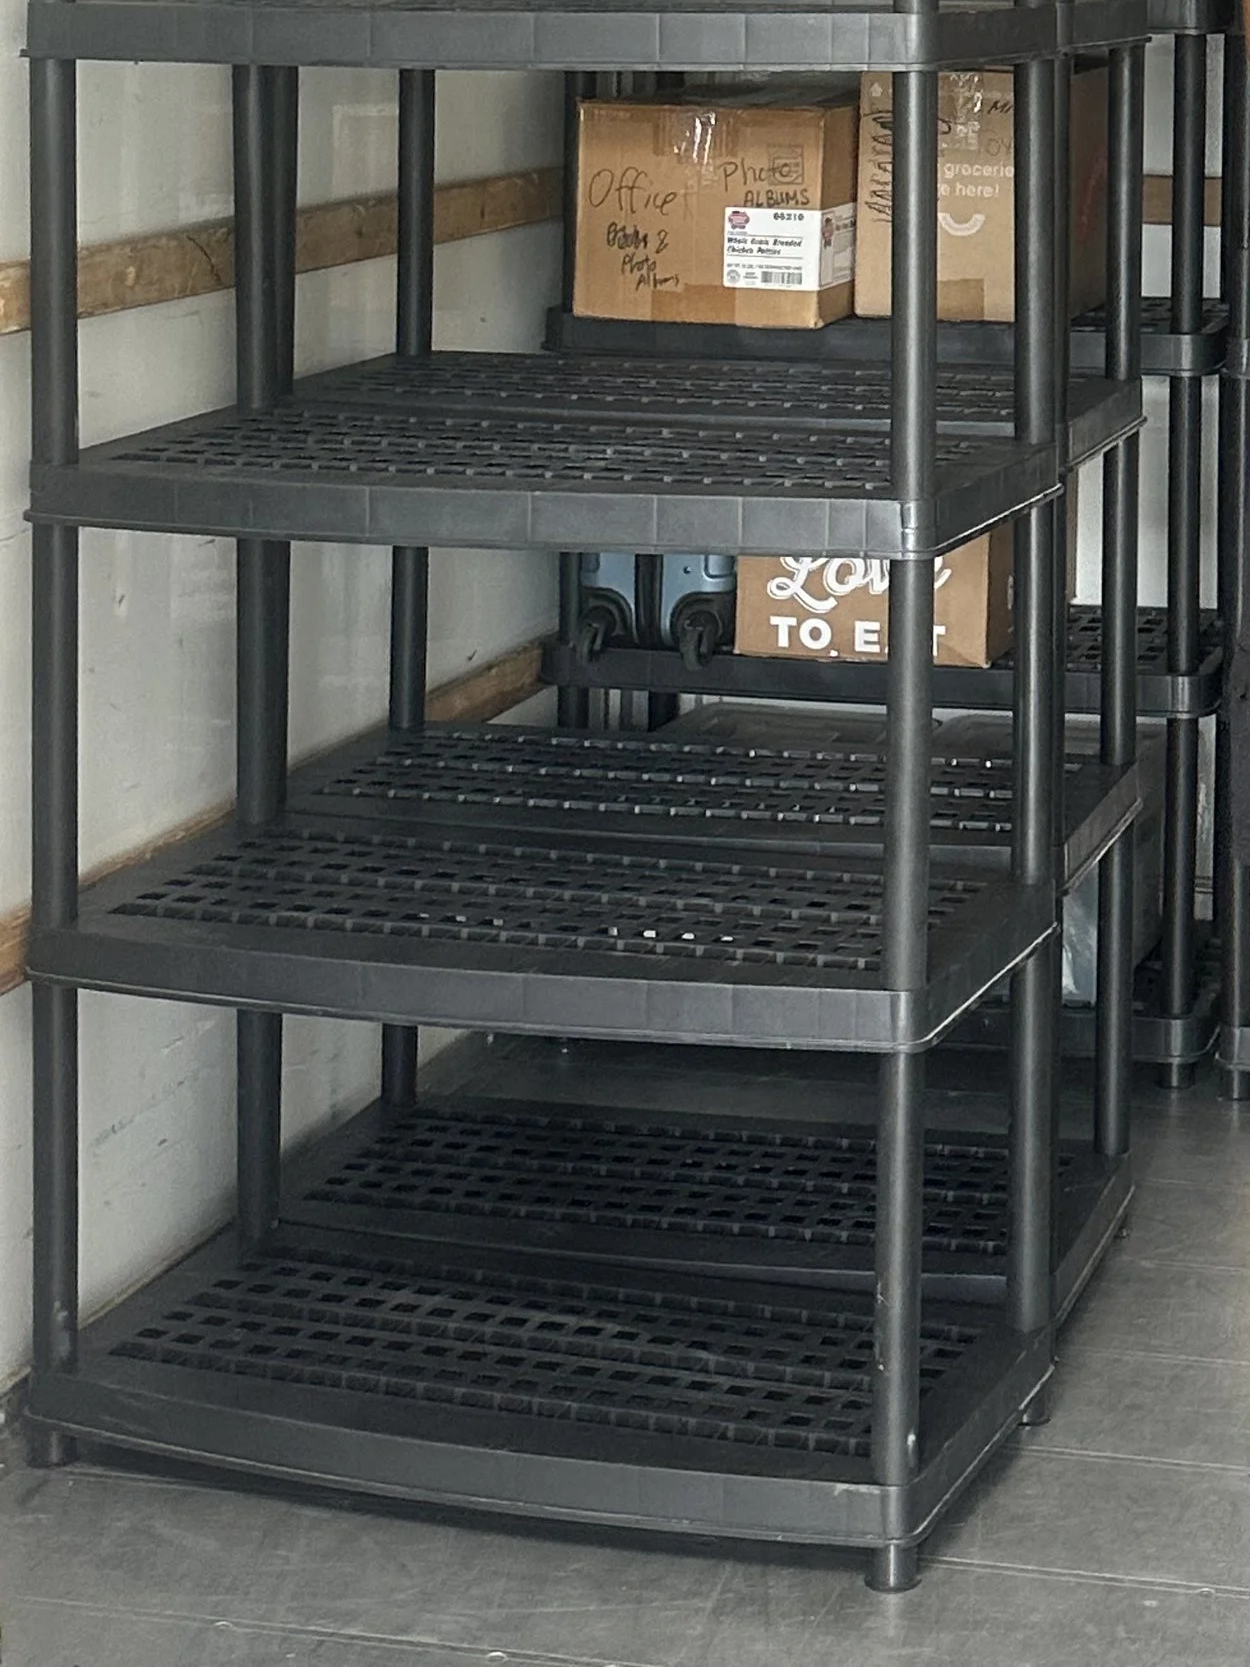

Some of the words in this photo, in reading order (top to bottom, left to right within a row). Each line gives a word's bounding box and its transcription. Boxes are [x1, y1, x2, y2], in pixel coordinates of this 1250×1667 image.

[721, 157, 791, 193] Photo
[943, 162, 1014, 179] grocerie
[588, 166, 679, 216] Office
[744, 189, 810, 209] ALBUMS
[956, 181, 999, 198] here!
[769, 615, 832, 650] TO
[854, 620, 946, 657] ET
